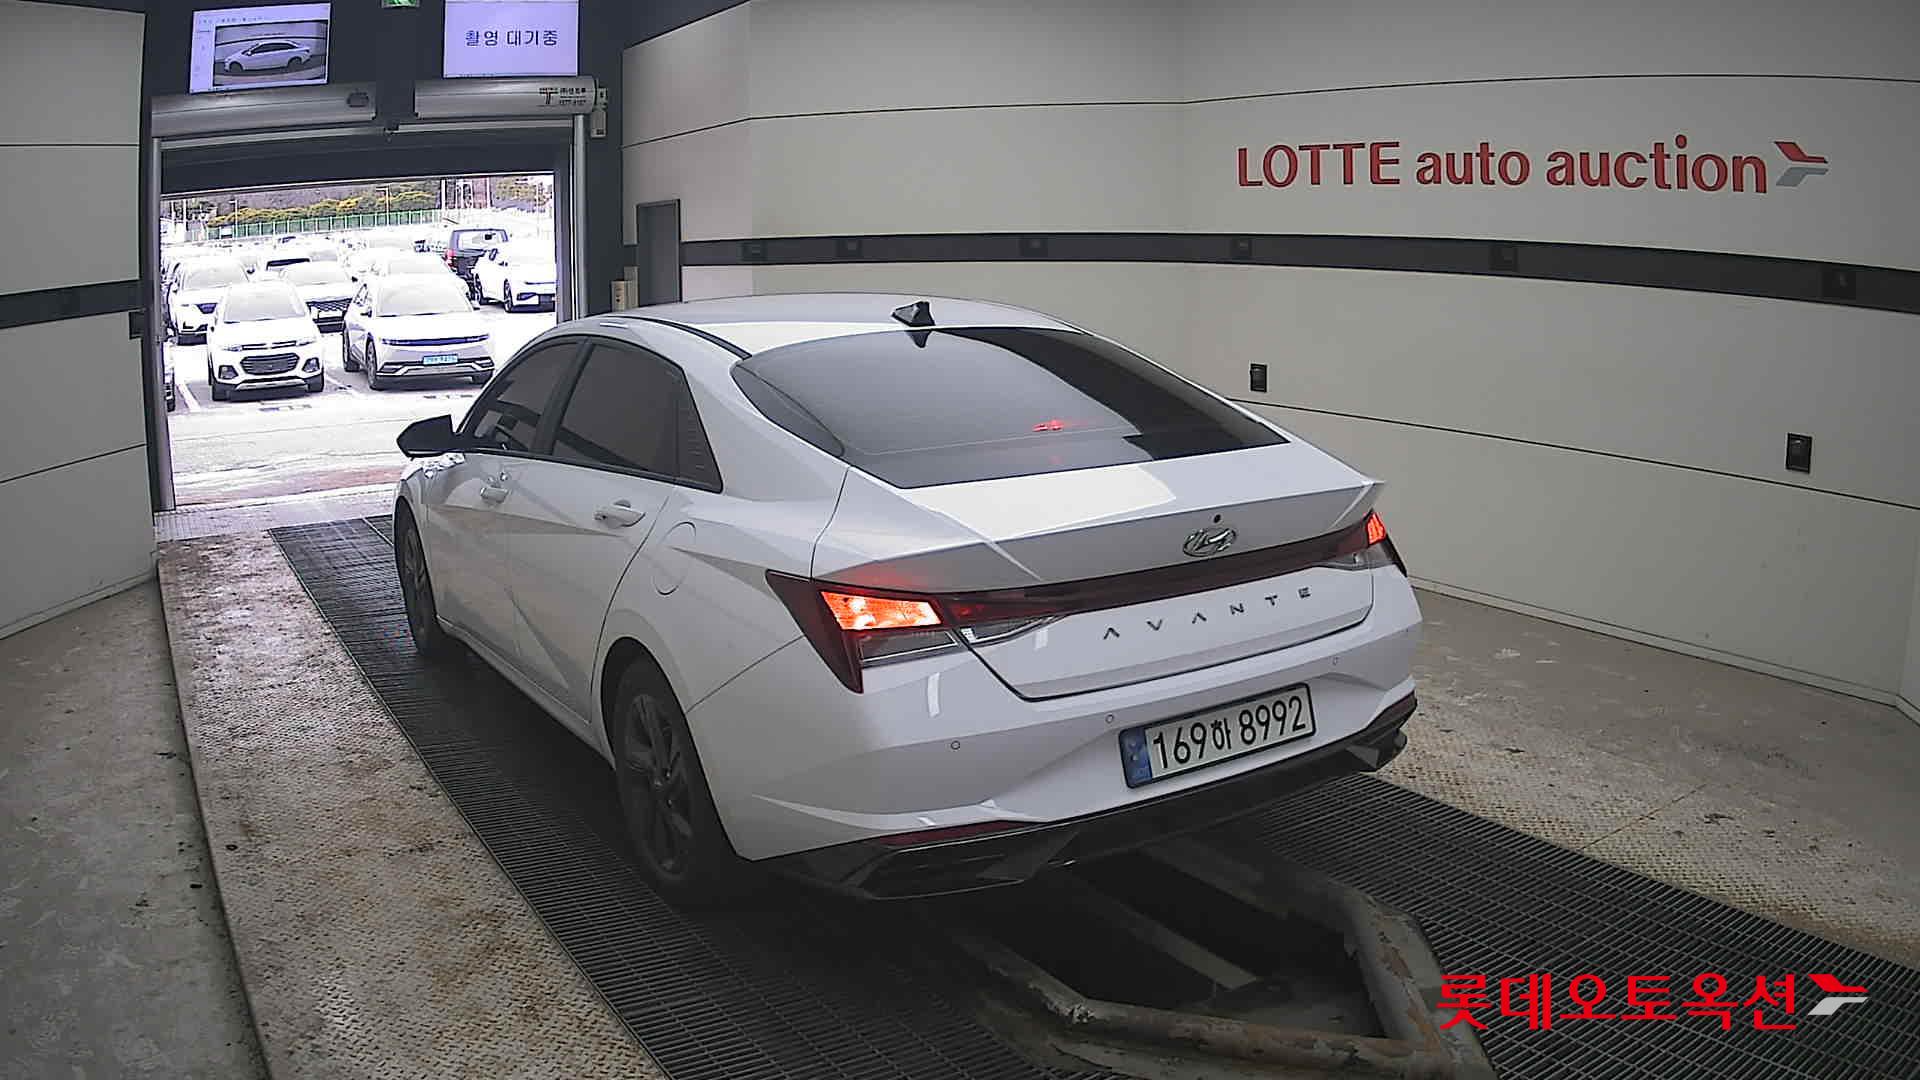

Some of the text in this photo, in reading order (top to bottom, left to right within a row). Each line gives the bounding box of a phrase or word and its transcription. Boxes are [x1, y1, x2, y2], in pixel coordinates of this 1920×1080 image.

[465, 30, 557, 46] 촬영 대기중
[1238, 134, 1766, 194] LOTTE auto auction
[1103, 587, 1311, 640] AVANTE
